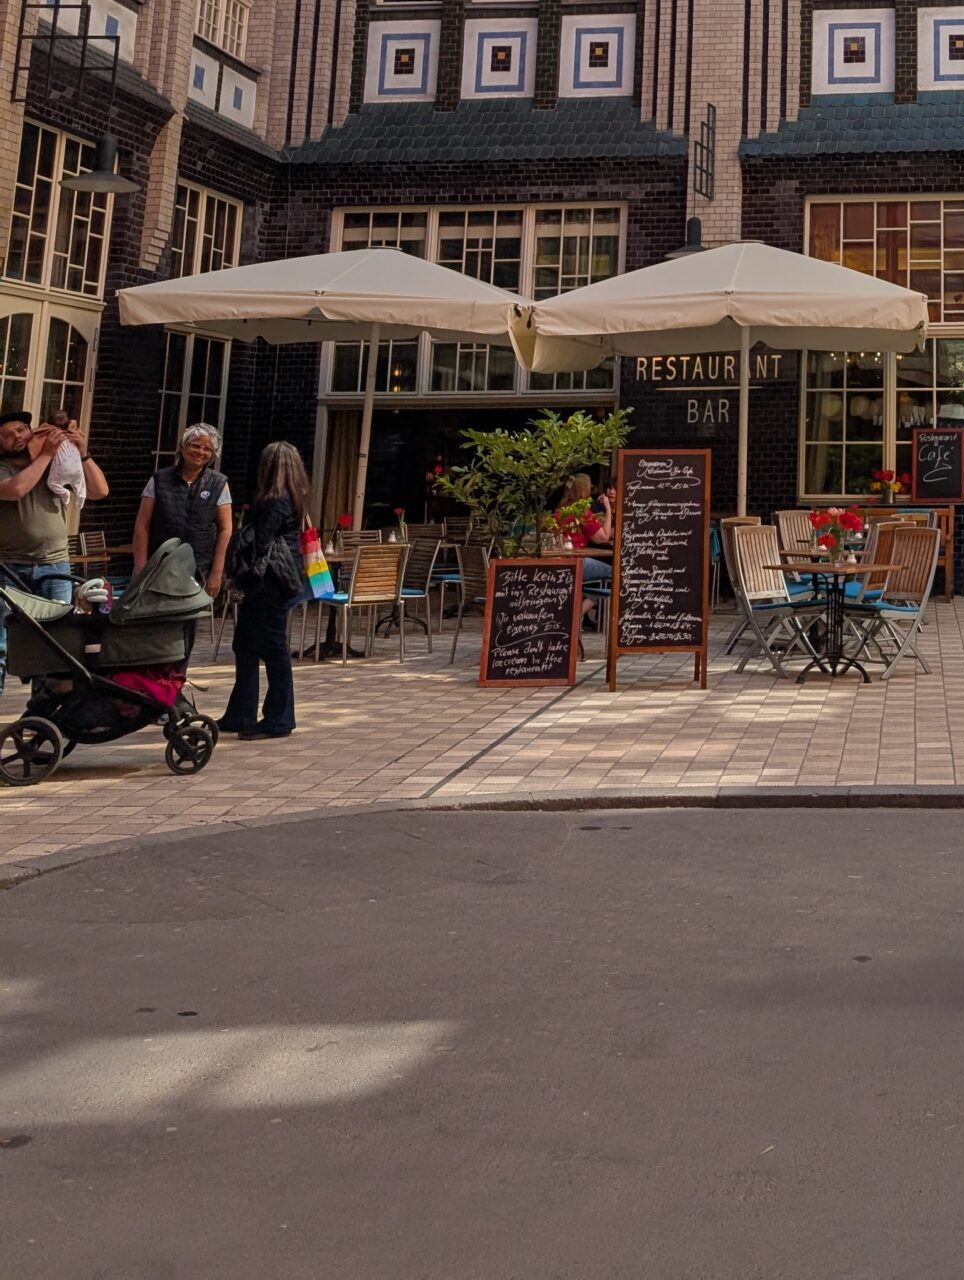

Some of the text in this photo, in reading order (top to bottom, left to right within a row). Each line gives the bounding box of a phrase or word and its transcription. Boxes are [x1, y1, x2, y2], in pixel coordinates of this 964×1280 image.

[636, 355, 782, 381] RESTAURNT
[687, 399, 730, 423] BAR
[918, 444, 955, 468] Café
[500, 569, 527, 586] Bitte
[495, 587, 508, 598] mit
[526, 583, 573, 599] Restaurant
[496, 612, 509, 625] Wir
[506, 624, 538, 637] eigenes
[491, 647, 519, 658] Please
[505, 664, 552, 676] restaurant
